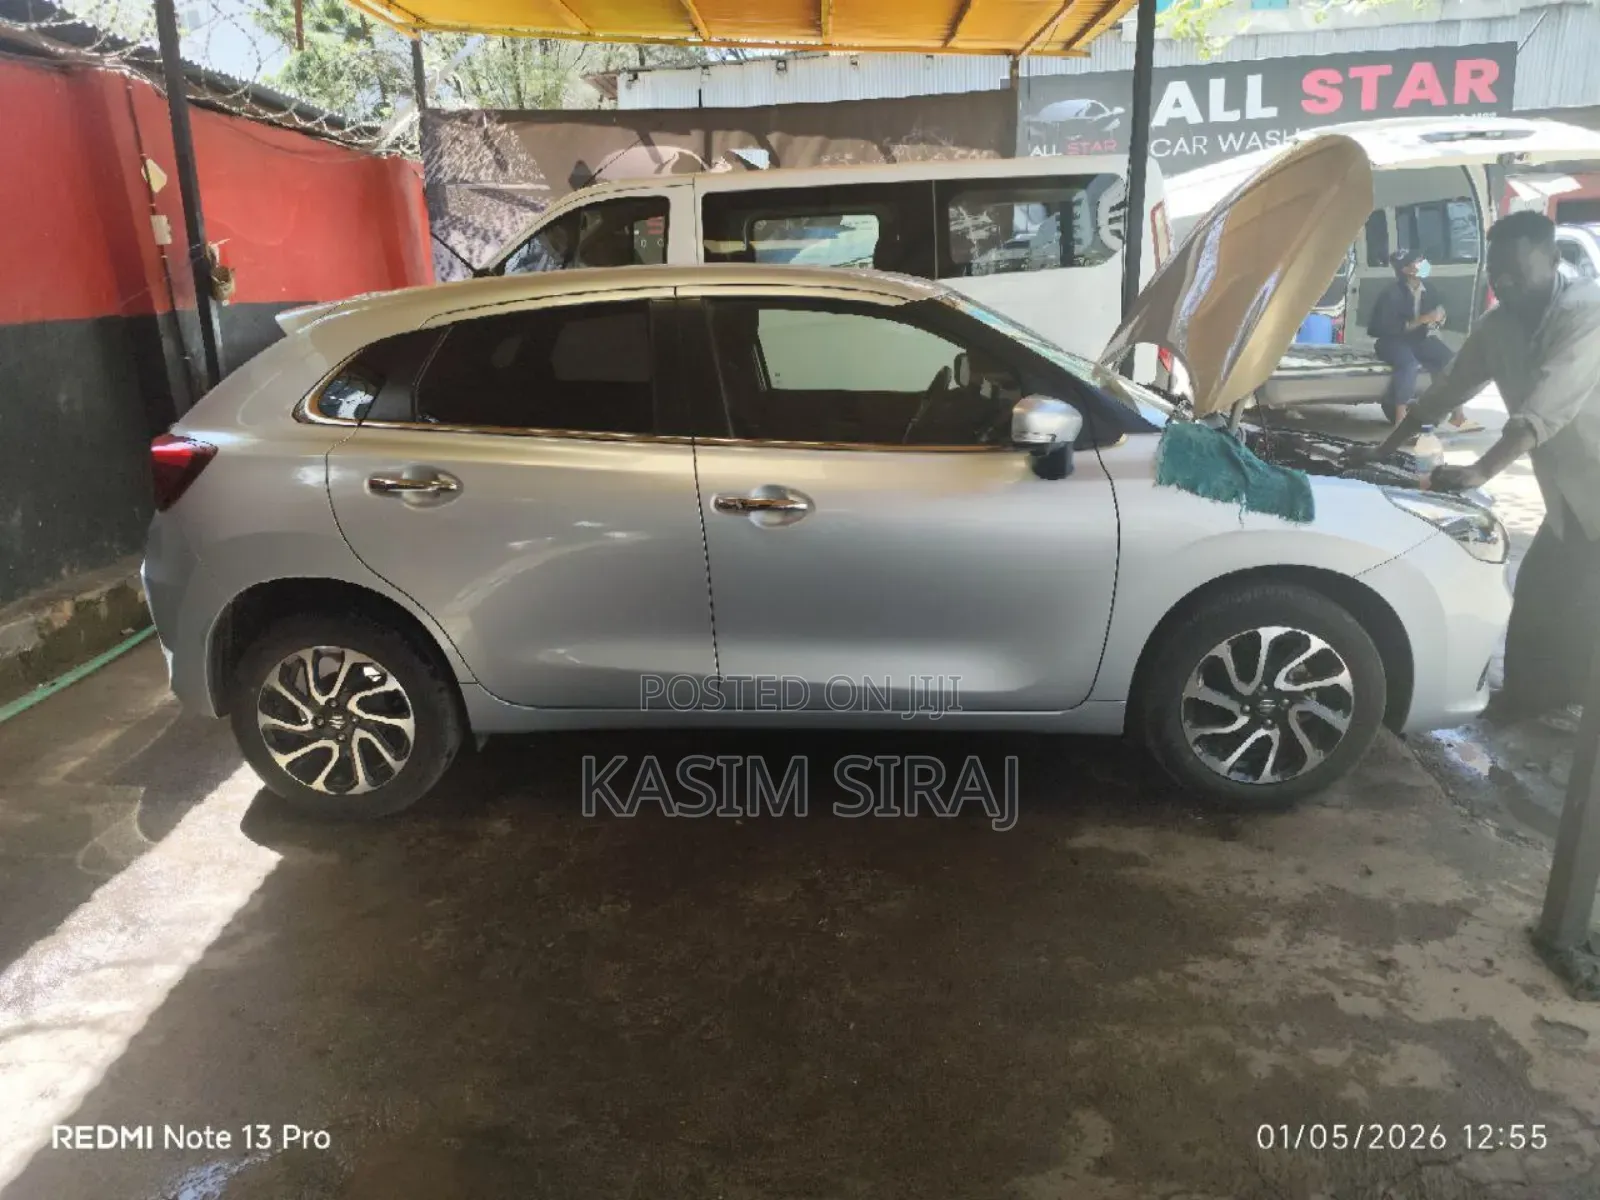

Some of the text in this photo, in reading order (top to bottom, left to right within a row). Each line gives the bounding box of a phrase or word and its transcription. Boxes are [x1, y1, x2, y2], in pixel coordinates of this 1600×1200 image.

[1151, 59, 1500, 127] ALL STAR
[1030, 140, 1118, 157] ALL STAR
[1150, 136, 1208, 157] CAR
